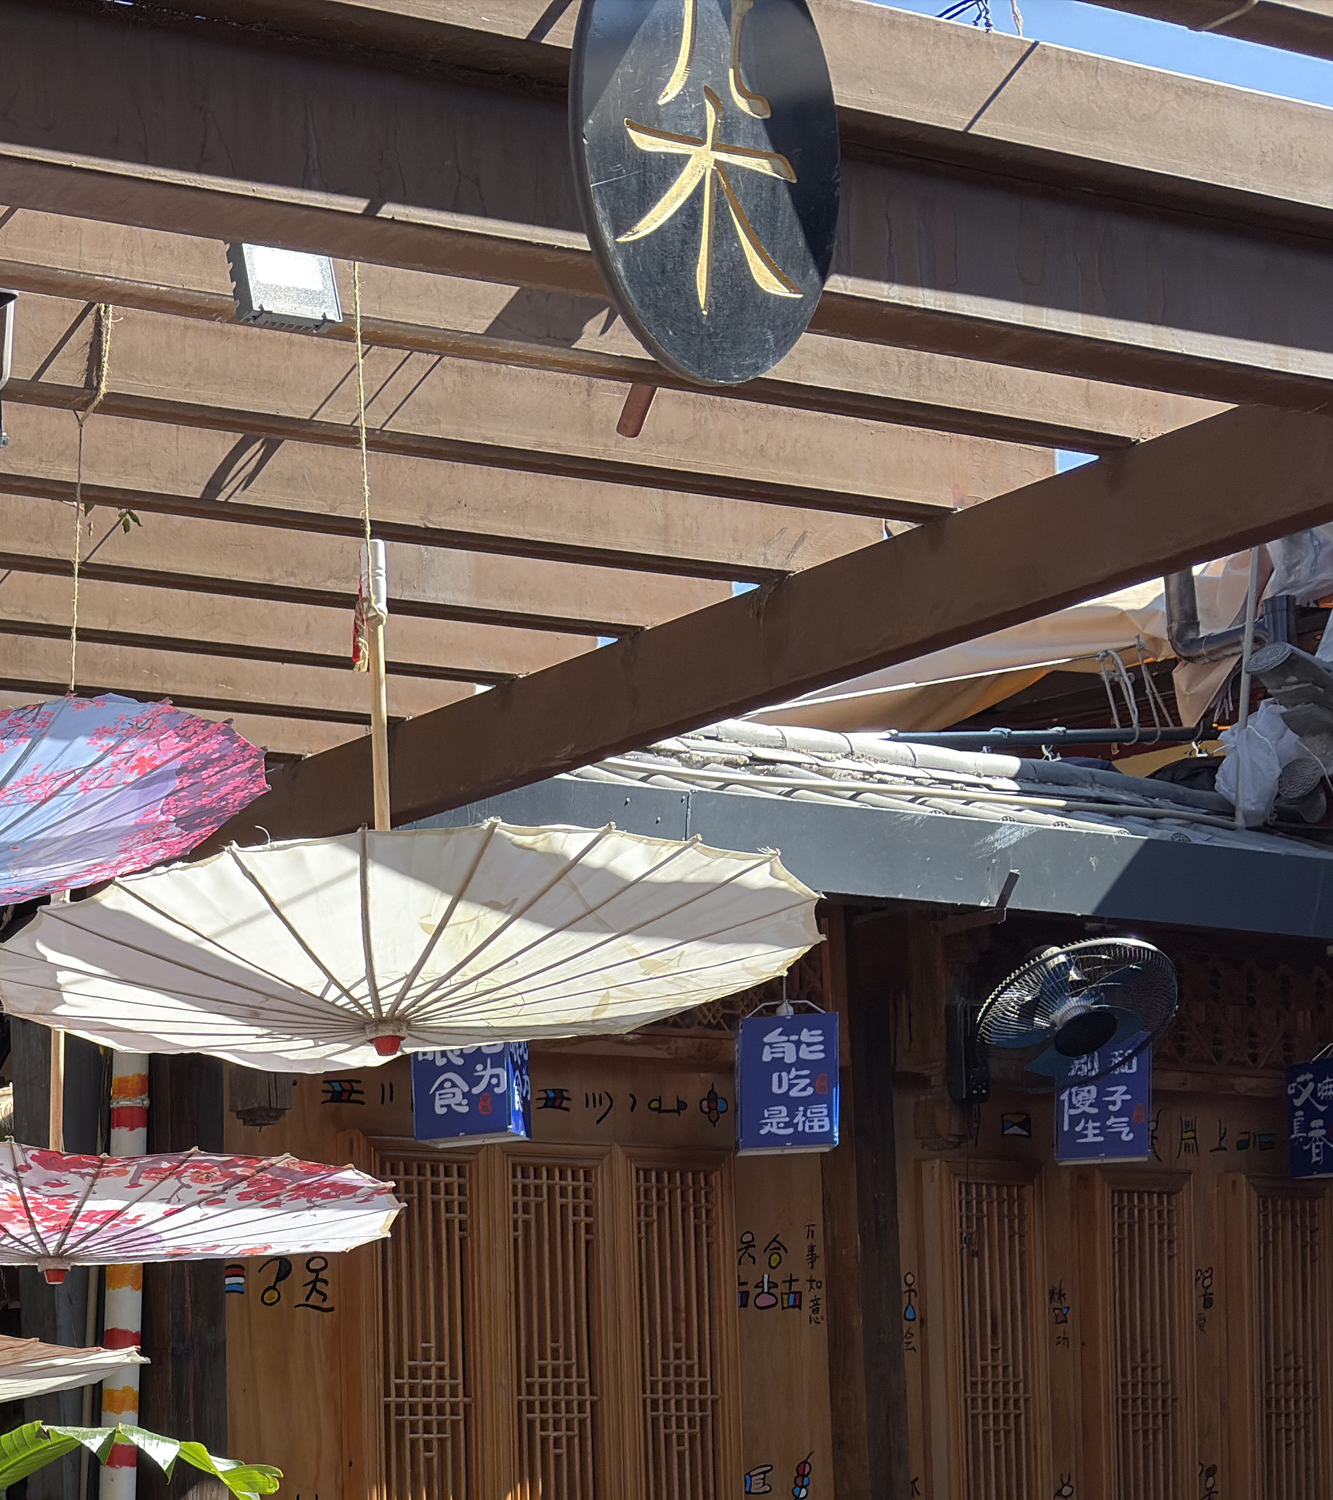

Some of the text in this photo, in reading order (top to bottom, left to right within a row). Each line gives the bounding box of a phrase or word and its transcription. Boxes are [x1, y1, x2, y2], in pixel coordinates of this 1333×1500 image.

[759, 1103, 830, 1136] 是福
[1075, 1115, 1134, 1144] 生气
[805, 1223, 825, 1326] 万事如意
